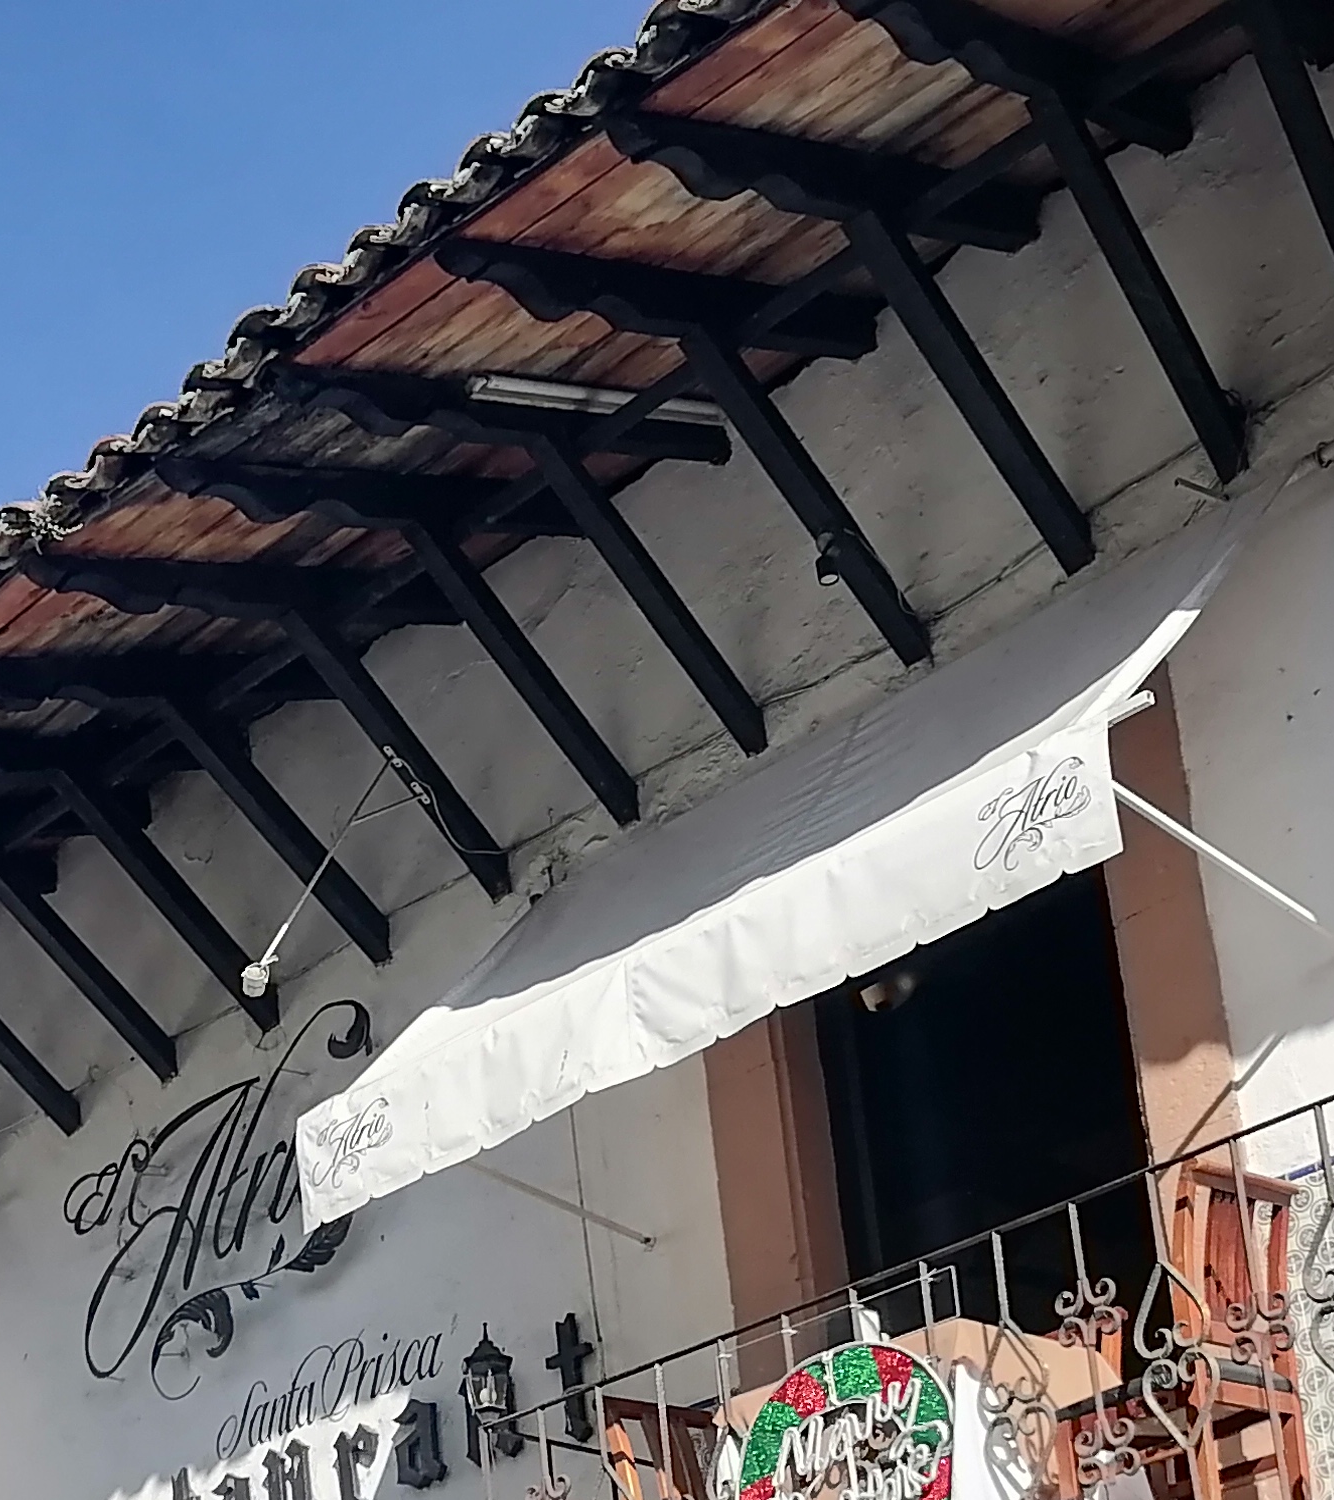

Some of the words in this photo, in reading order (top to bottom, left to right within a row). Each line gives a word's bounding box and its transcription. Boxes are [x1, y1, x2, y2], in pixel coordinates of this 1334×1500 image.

[973, 756, 1085, 870] Atrio
[85, 1000, 373, 1378] Atri
[312, 1096, 390, 1188] Atrio
[216, 1344, 335, 1460] Santa
[320, 1328, 444, 1423] Prisca
